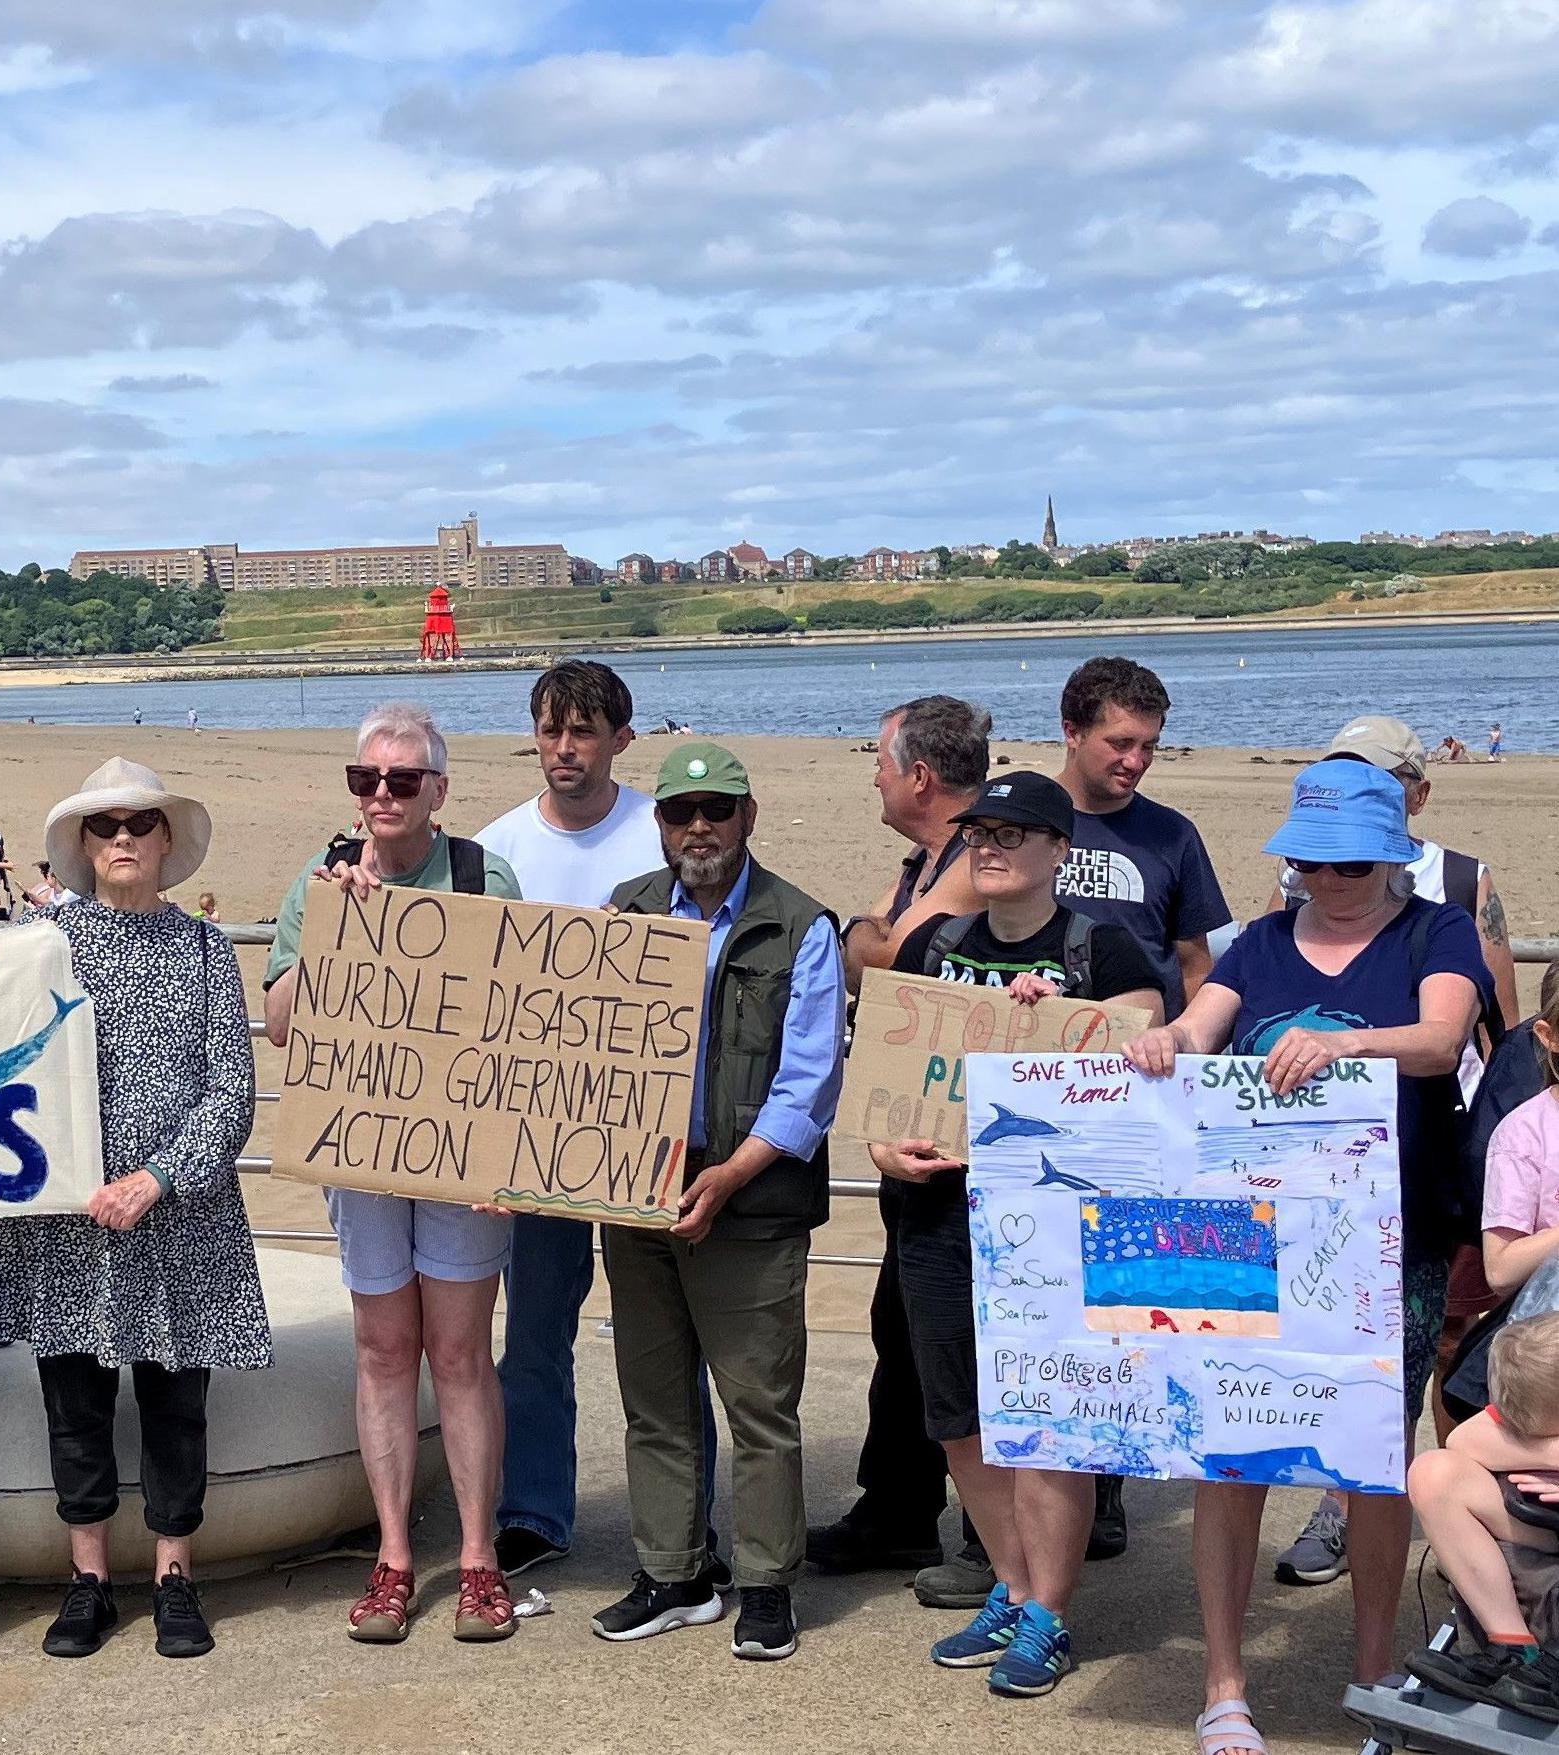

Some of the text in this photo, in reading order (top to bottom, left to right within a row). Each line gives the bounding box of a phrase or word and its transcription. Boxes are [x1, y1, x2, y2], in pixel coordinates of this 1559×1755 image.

[1069, 847, 1109, 866] THE
[1055, 863, 1108, 882] ORTH
[1055, 879, 1108, 899] FACE
[336, 889, 690, 988] NO MORE
[293, 956, 694, 1059] NURDLE DISASTERS
[884, 985, 1039, 1054] STOP
[284, 1027, 691, 1134] DEMAND GOVERNMENT
[1012, 1058, 1136, 1083] SAVE THEIR
[1201, 1059, 1373, 1089] SAV OUR
[1061, 1081, 1131, 1105] home!
[1235, 1085, 1328, 1111] SHORE
[305, 1106, 684, 1208] ACTION NOW!!
[1290, 1209, 1357, 1307] CLEAN IT
[1318, 1279, 1348, 1312] UP!
[995, 1349, 1133, 1387] Protect
[1216, 1379, 1338, 1401] SAVE OUR
[1001, 1389, 1167, 1425] OUR ANIMALS
[1224, 1406, 1324, 1428] WILDLIFE
